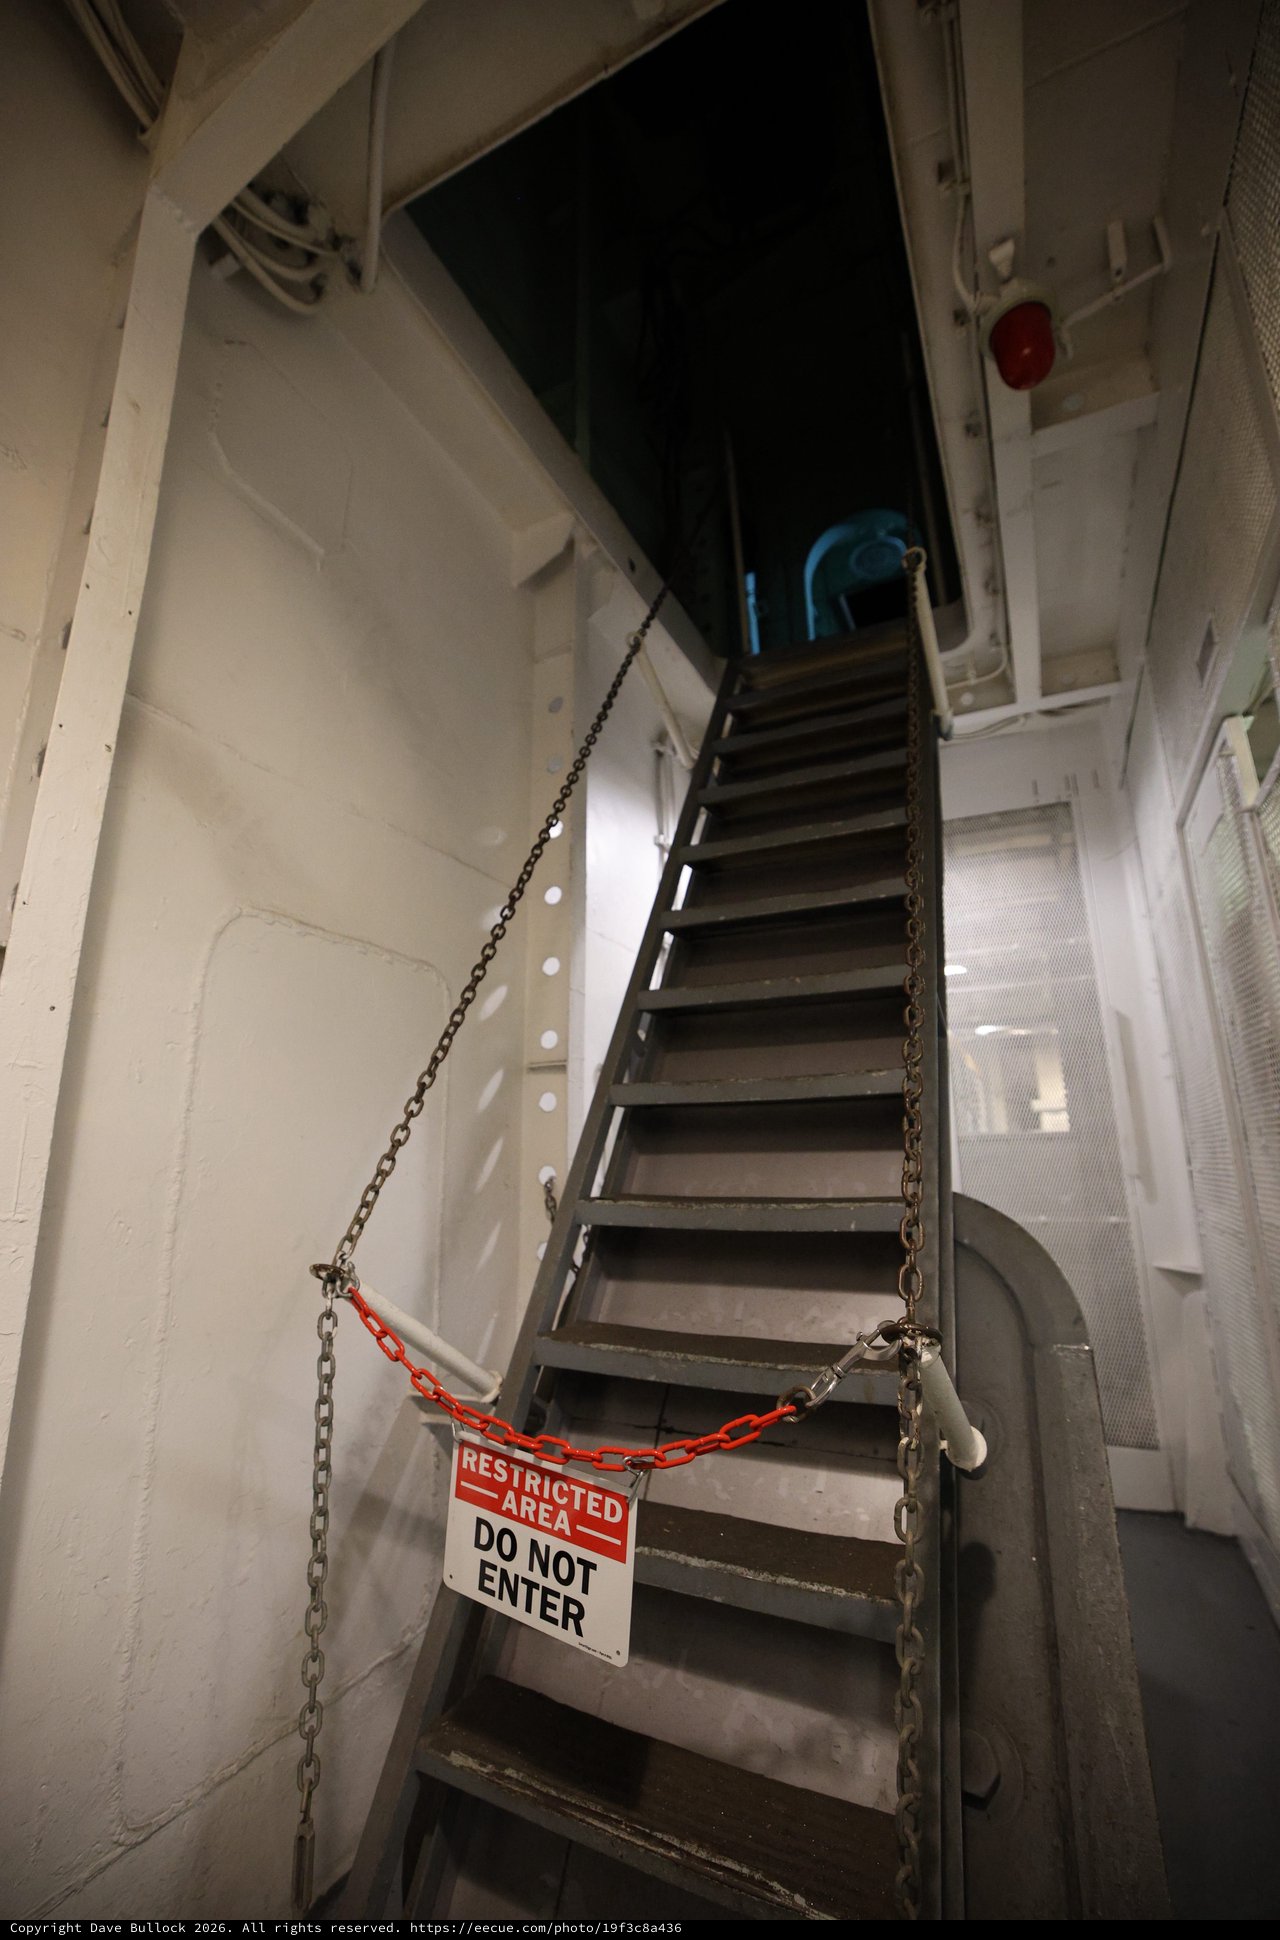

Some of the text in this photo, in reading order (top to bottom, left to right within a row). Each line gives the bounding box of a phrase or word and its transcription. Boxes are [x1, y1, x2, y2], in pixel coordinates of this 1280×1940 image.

[462, 1449, 623, 1524] RESTRICTED
[501, 1490, 571, 1536] AREA
[473, 1516, 598, 1596] DO NOT
[477, 1558, 586, 1638] ENTER
